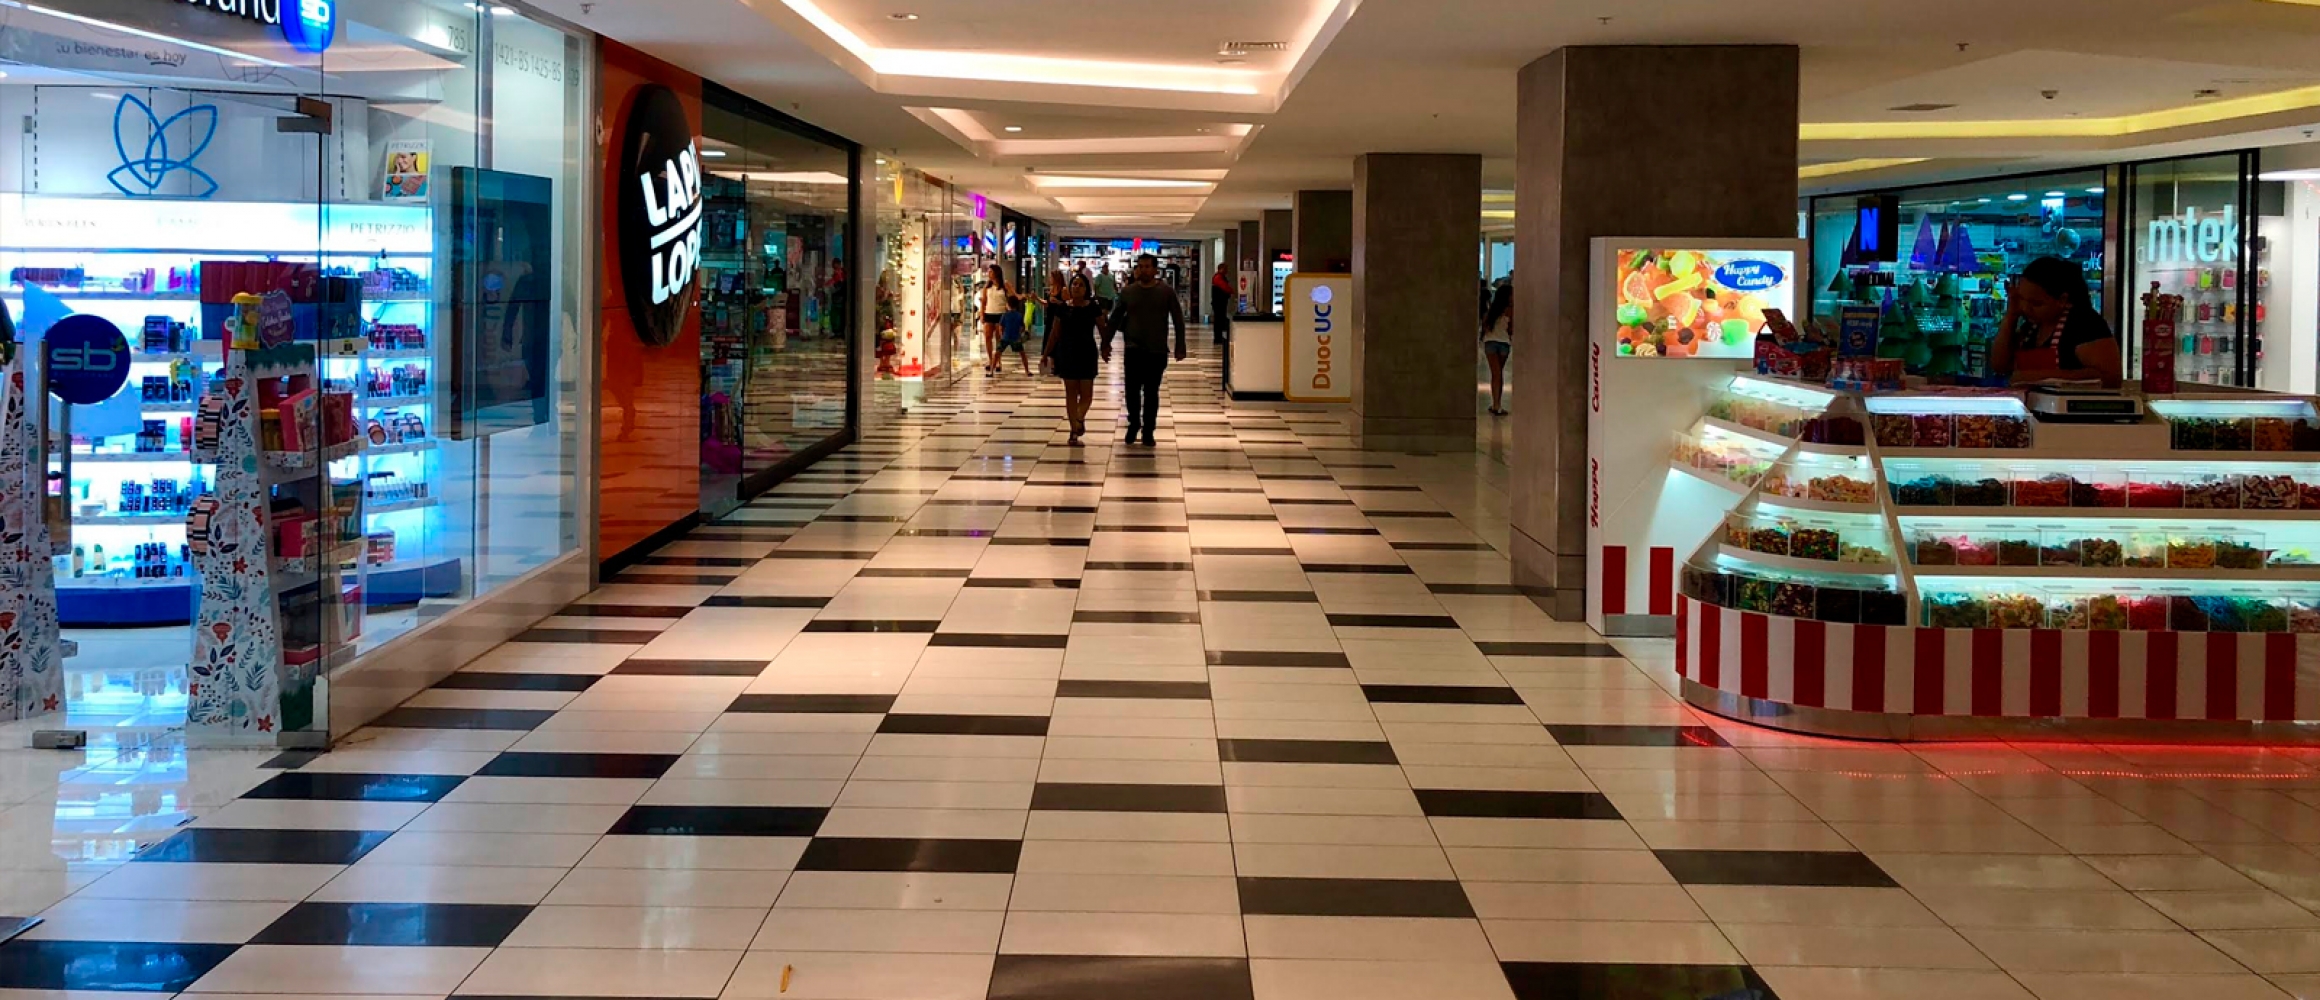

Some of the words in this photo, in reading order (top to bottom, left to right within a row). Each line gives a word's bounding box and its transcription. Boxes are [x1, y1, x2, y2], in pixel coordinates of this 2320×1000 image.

[74, 41, 139, 59] bienestar
[145, 50, 160, 60] es
[163, 49, 187, 66] hoy
[2148, 204, 2238, 262] mtek
[1723, 263, 1760, 277] Happy
[1736, 274, 1774, 287] Candy
[51, 340, 117, 371] sb
[1591, 341, 1600, 413] Candy
